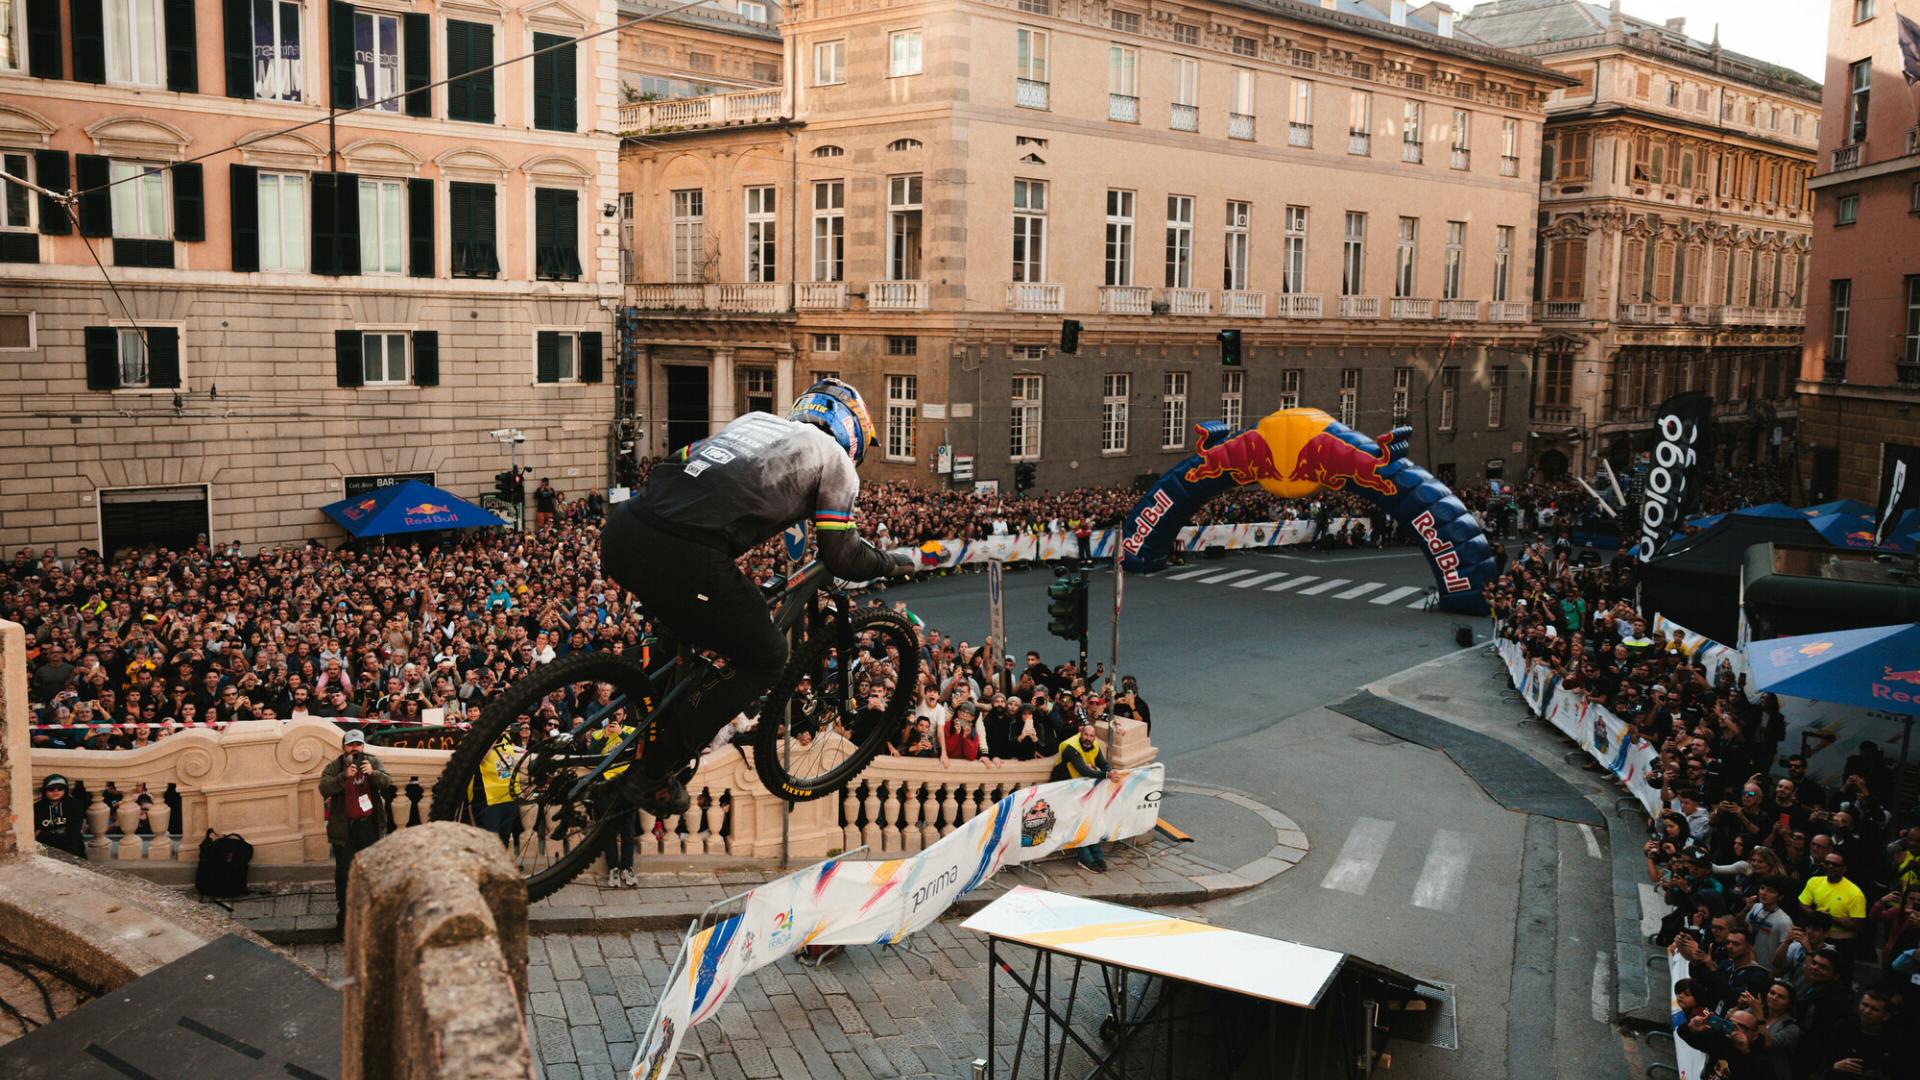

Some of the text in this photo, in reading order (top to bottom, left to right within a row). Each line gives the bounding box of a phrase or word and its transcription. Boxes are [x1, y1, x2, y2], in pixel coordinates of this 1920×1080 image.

[376, 478, 394, 487] BAR
[405, 513, 459, 526] Red Bull
[1122, 489, 1173, 555] Red Bull
[1412, 510, 1471, 592] Red Bull
[642, 696, 657, 742] MAXIS
[782, 783, 812, 797] MAXXIS
[912, 865, 958, 914] prima
